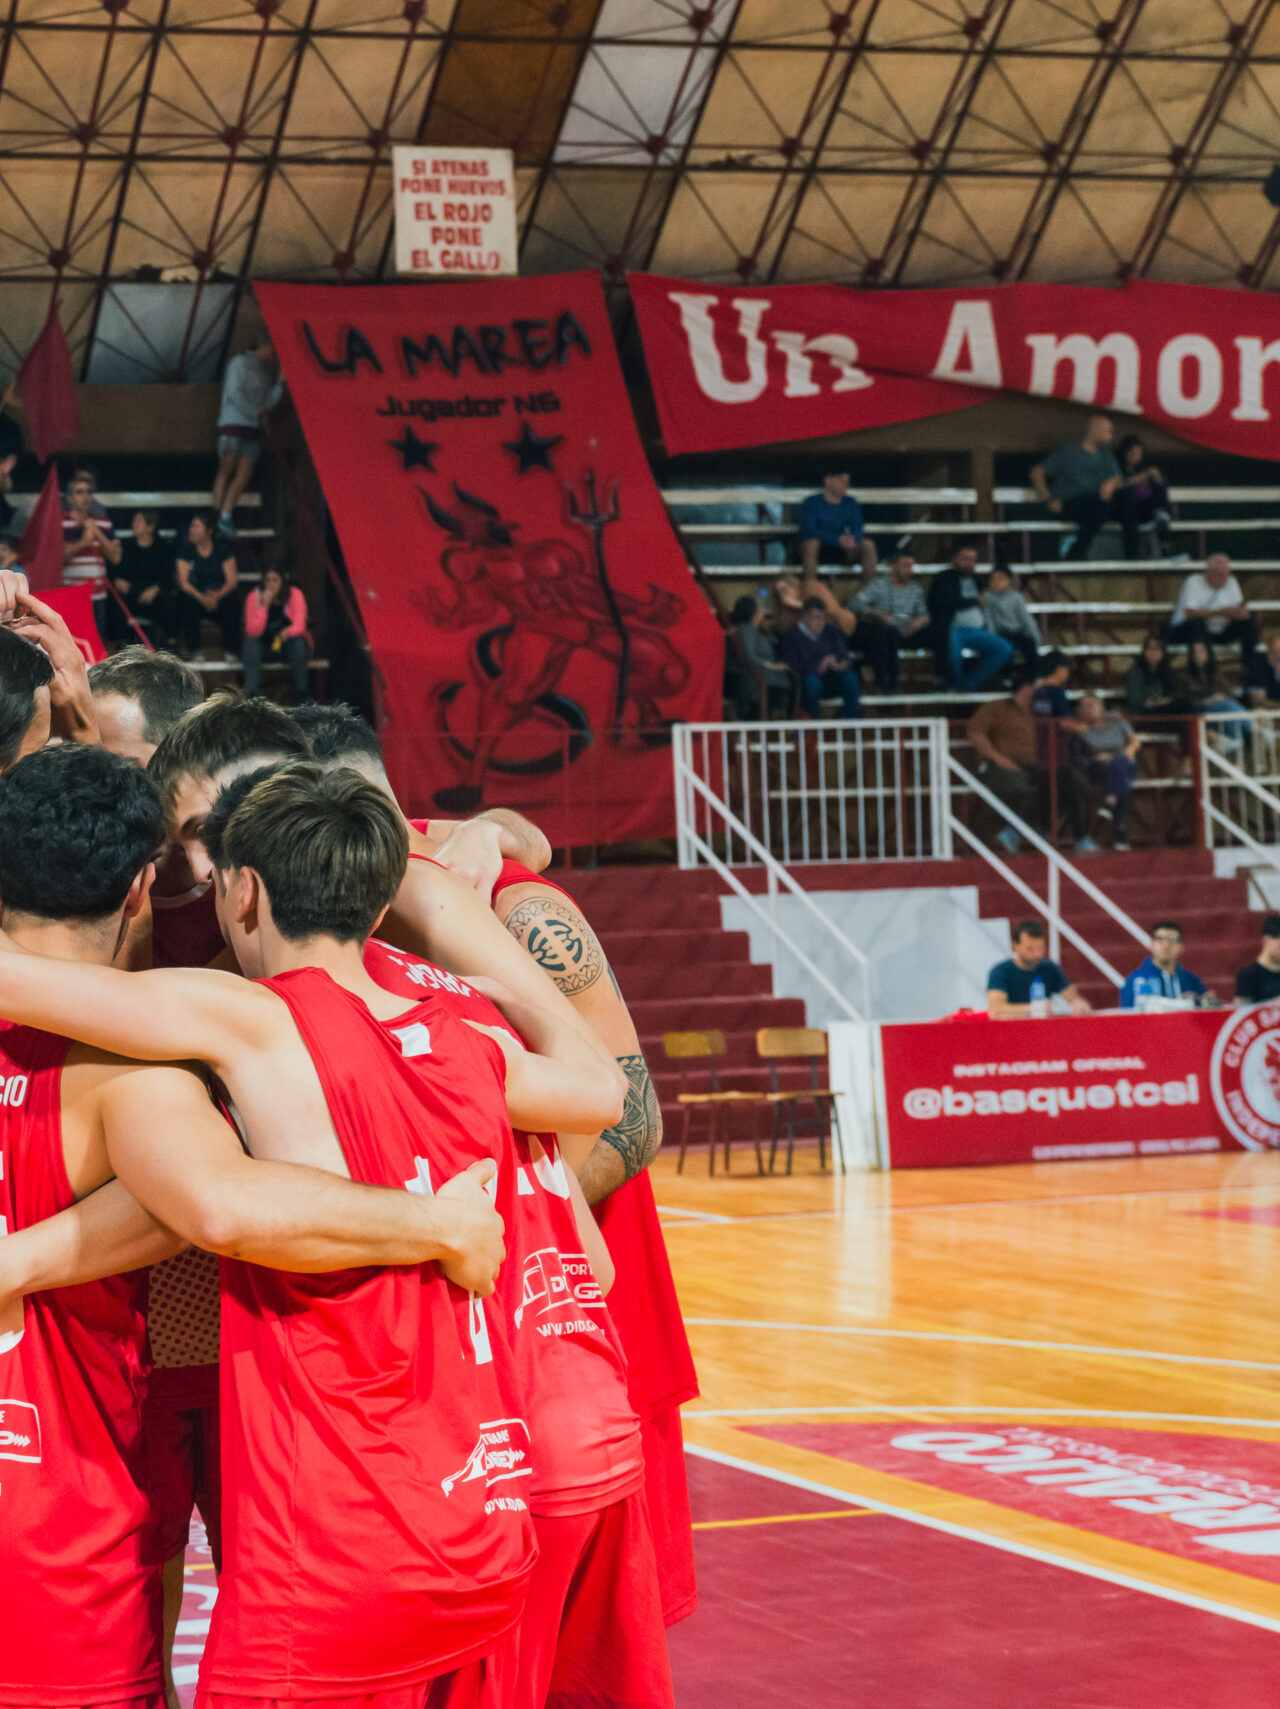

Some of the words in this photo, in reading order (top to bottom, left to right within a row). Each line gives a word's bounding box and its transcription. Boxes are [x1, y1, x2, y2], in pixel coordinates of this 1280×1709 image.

[412, 159, 427, 176] SI
[431, 159, 489, 177] ATENAS
[400, 178, 442, 194] PONE
[414, 202, 437, 221] EL
[443, 202, 493, 223] ROJO
[431, 226, 483, 247] PONE
[411, 249, 433, 270] EL
[440, 250, 501, 271] GALLO
[301, 319, 384, 376] LA
[400, 310, 593, 378] MAREA
[668, 291, 875, 404] Un
